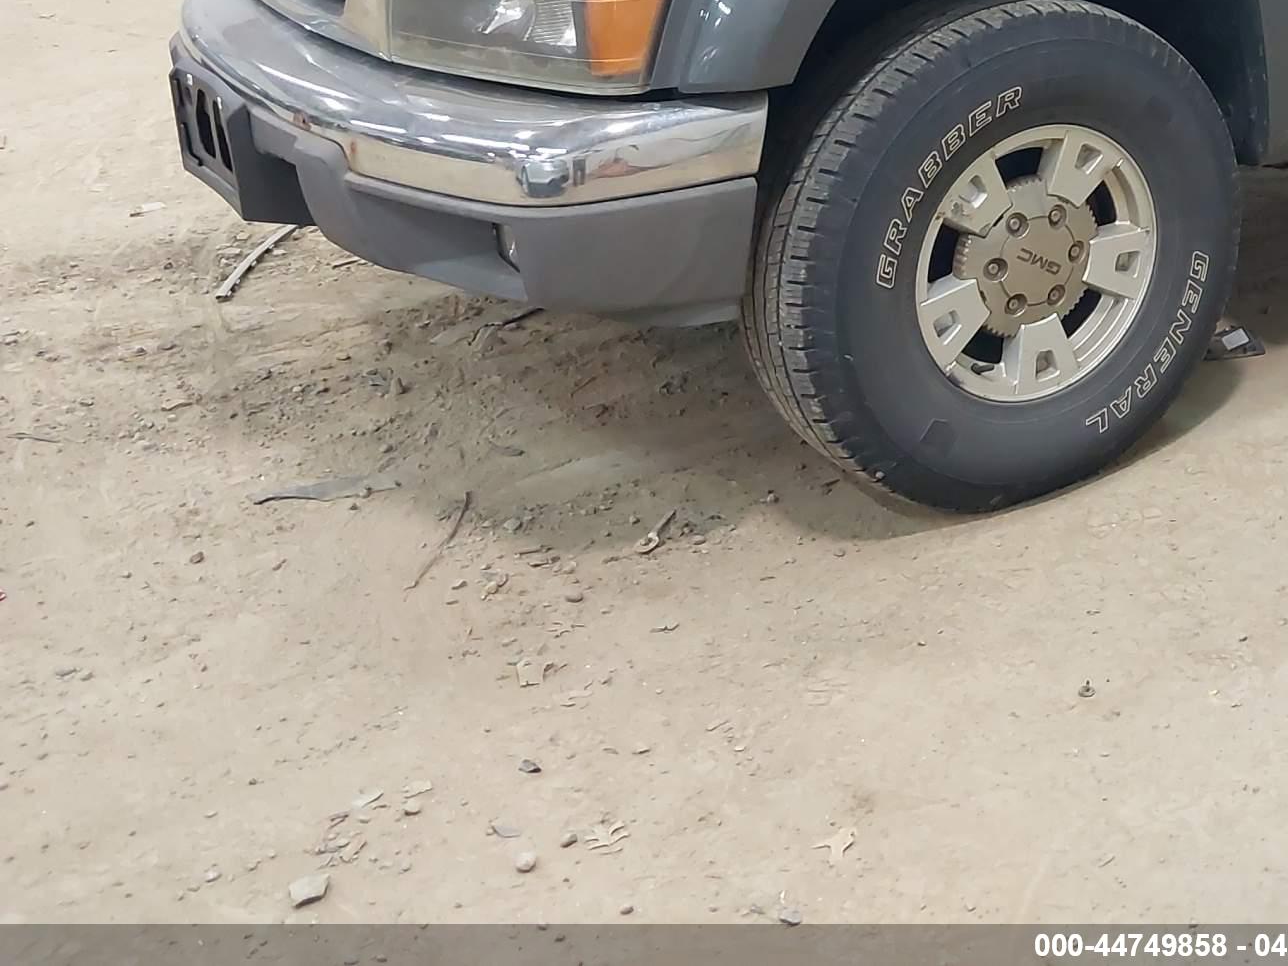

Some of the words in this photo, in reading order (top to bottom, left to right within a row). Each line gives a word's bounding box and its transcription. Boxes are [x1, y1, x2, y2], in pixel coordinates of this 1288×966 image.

[876, 86, 1022, 289] GRABBER
[1016, 247, 1062, 276] GMC
[1085, 250, 1209, 433] GENERAL
